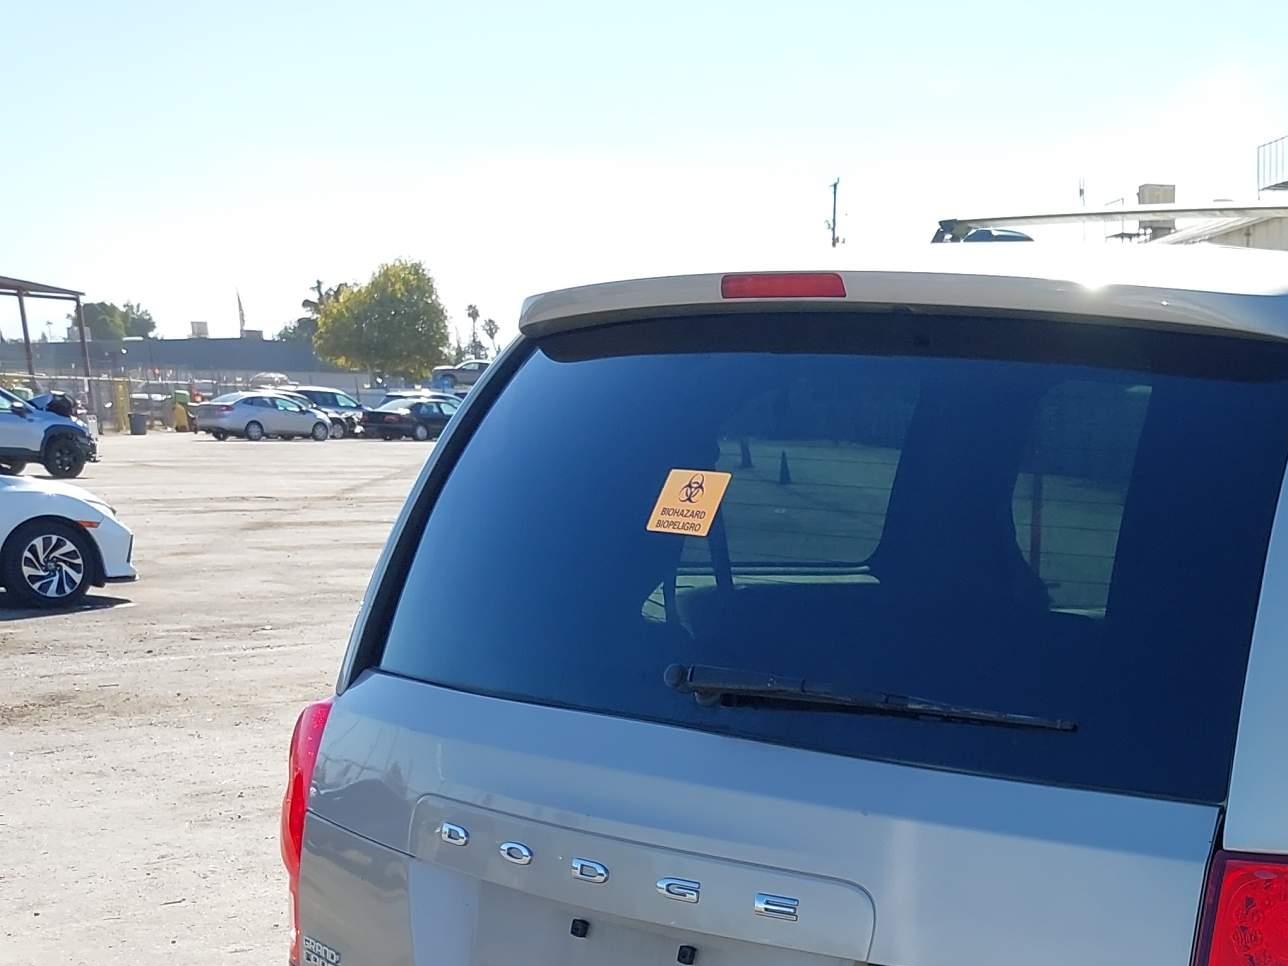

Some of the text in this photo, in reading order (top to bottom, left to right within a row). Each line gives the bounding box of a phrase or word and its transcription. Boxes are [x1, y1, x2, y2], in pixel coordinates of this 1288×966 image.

[660, 507, 706, 520] BIOHAZARD
[655, 519, 702, 532] BIOPELIGRO
[440, 821, 800, 922] DODGE
[303, 935, 340, 964] GRAND
